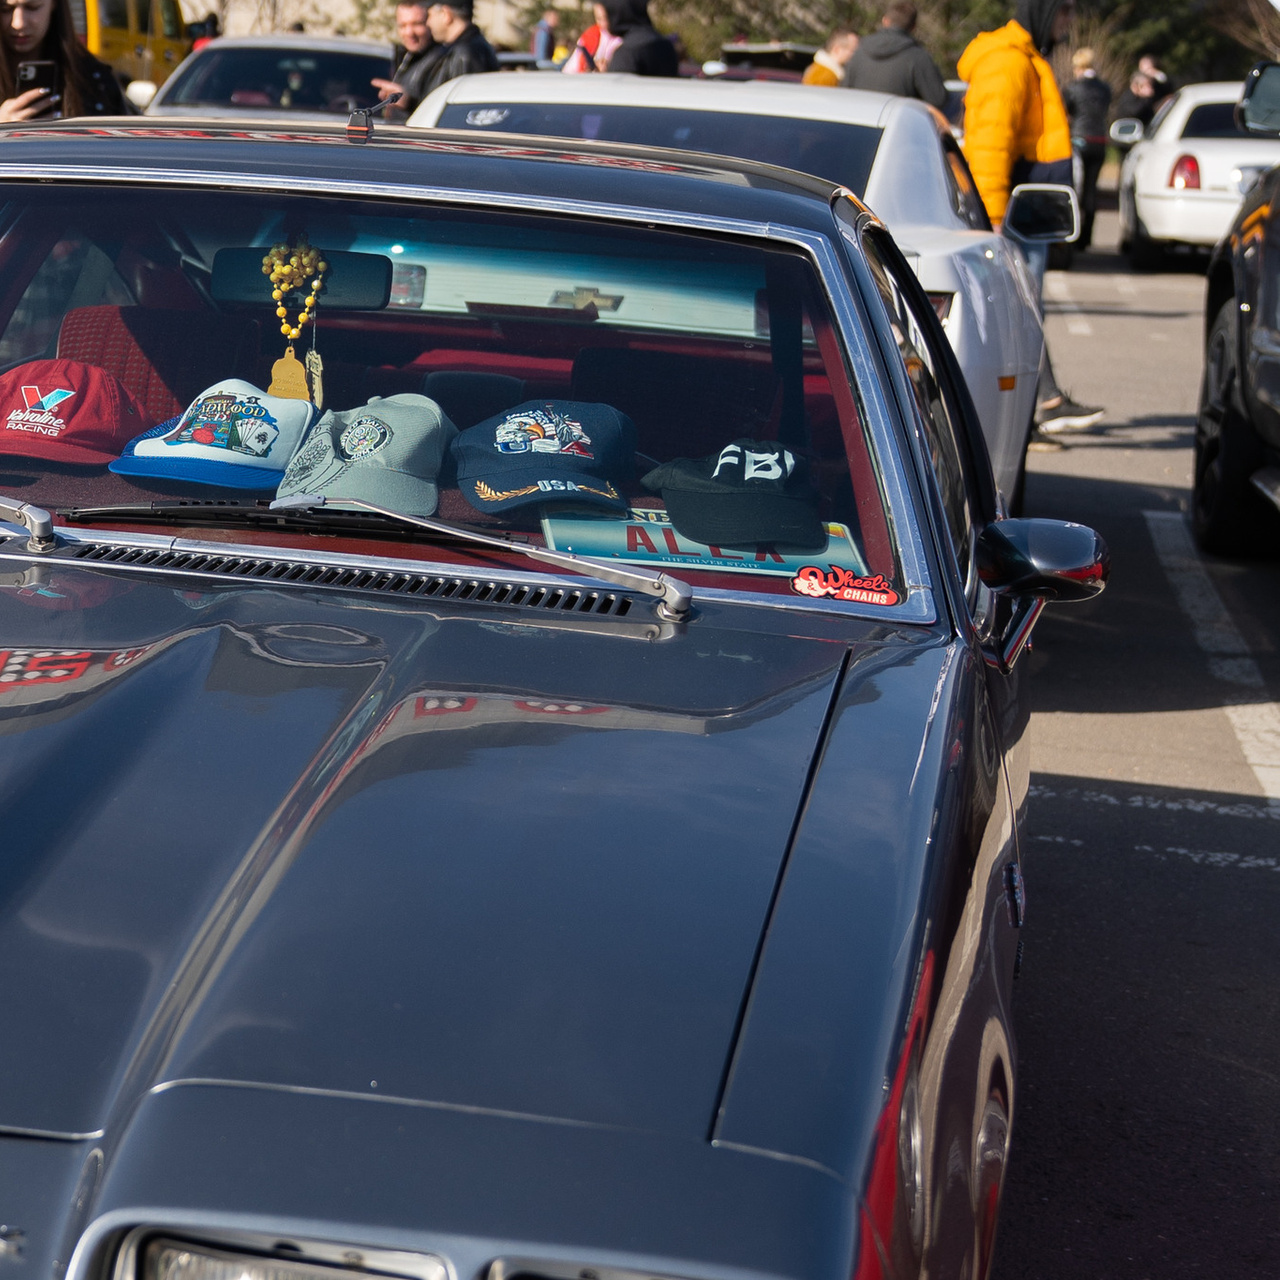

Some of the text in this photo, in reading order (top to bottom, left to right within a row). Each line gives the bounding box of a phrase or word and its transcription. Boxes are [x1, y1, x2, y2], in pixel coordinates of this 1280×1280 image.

[6, 409, 64, 427] Valvoline
[6, 423, 60, 436] RACING
[711, 444, 795, 480] FBI
[537, 480, 580, 492] USA
[686, 558, 723, 566] SILVER
[799, 565, 889, 591] Wheels
[843, 588, 888, 605] CHAINS
